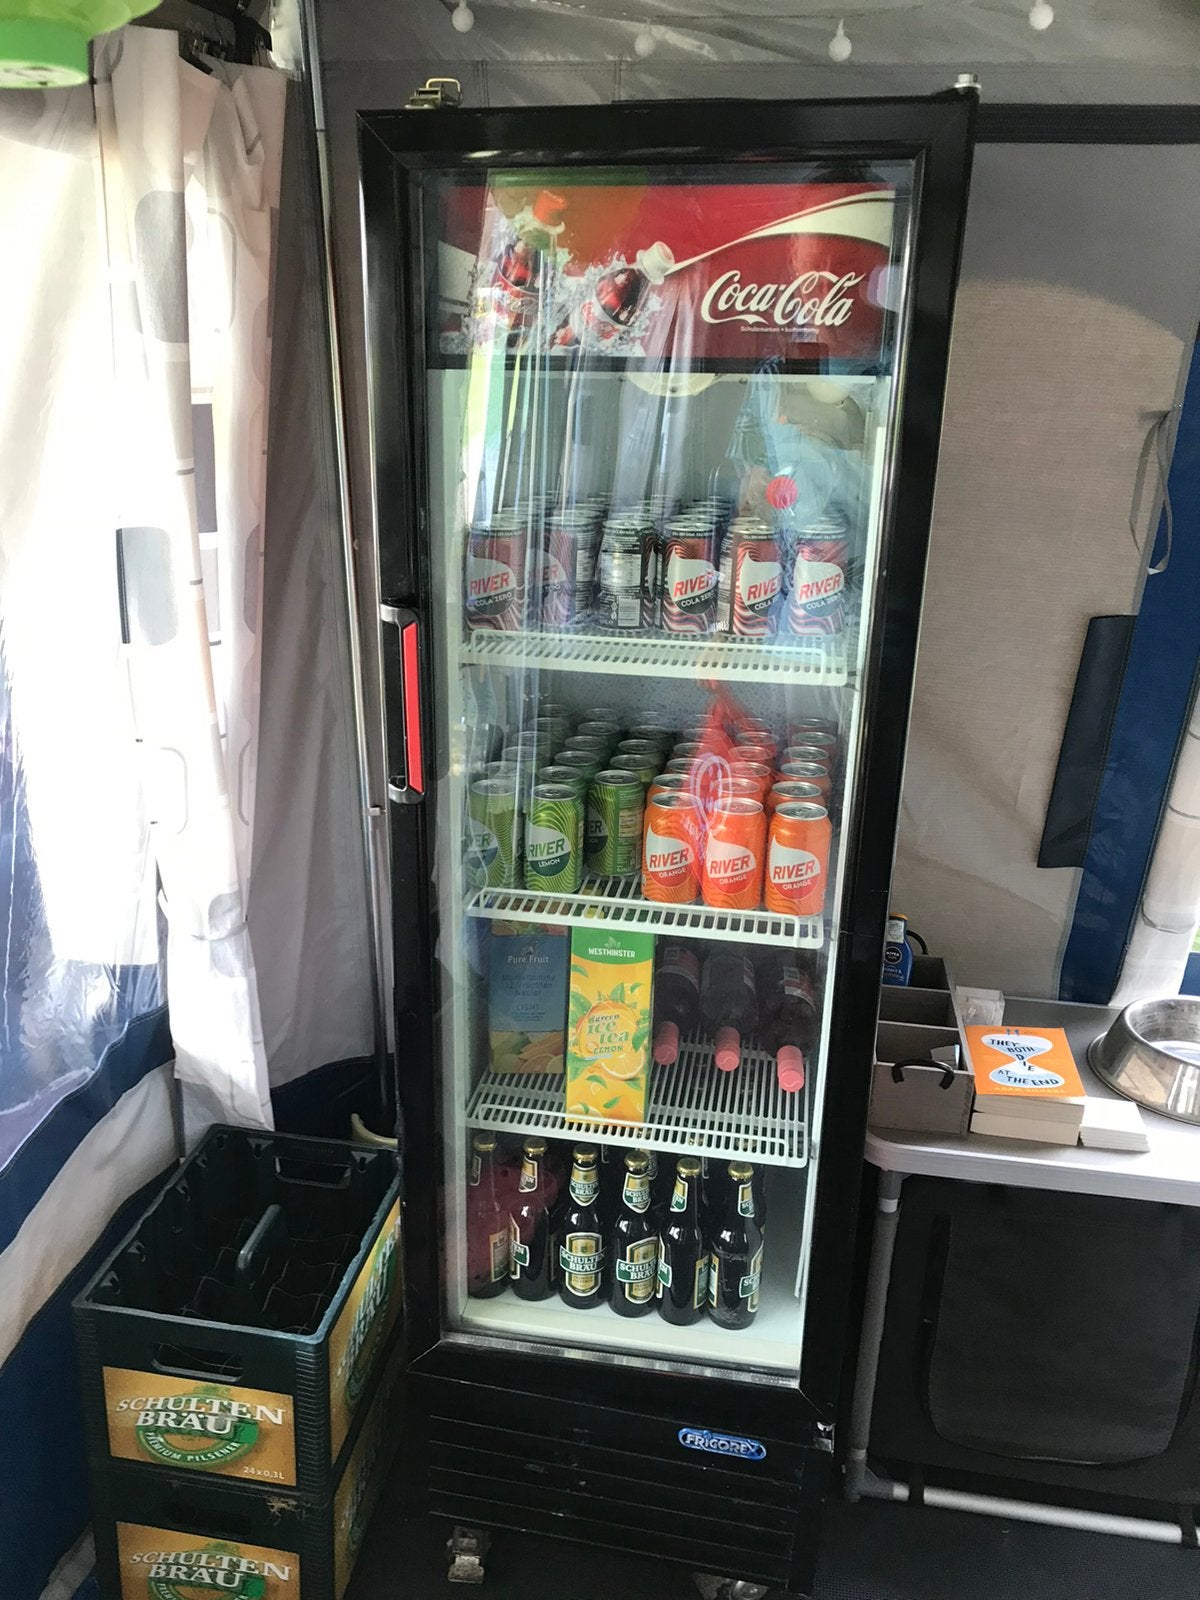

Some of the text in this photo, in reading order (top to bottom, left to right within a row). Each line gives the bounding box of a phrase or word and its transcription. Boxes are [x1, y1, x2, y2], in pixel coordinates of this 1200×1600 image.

[701, 269, 866, 326] Coca-Cola
[470, 572, 510, 596] RIVER
[799, 573, 842, 600] RIVER
[494, 591, 513, 603] ZERO
[681, 597, 701, 607] COLA
[806, 600, 826, 610] COLA
[528, 838, 566, 858] RIVER
[537, 858, 561, 868] LEMON
[649, 847, 690, 868] RIVER
[709, 854, 751, 875] RIVER
[773, 859, 816, 880] RIVER
[658, 868, 687, 878] ORANGE
[718, 875, 748, 885] ORANGE
[782, 880, 812, 891] ORANGE
[529, 954, 550, 963] Fruit
[588, 947, 636, 958] WESTMINSTER
[990, 1038, 1019, 1047] THEY
[594, 1046, 624, 1055] LEMON
[1007, 1046, 1036, 1054] BOTH
[1007, 1076, 1060, 1087] THE END
[116, 1396, 286, 1425] SCHULTEN
[135, 1411, 237, 1434] BRÄU
[144, 1431, 242, 1462] PREMIUM PILSENER
[129, 1551, 292, 1581] SCHULTEN
[148, 1563, 244, 1588] BRÄU
